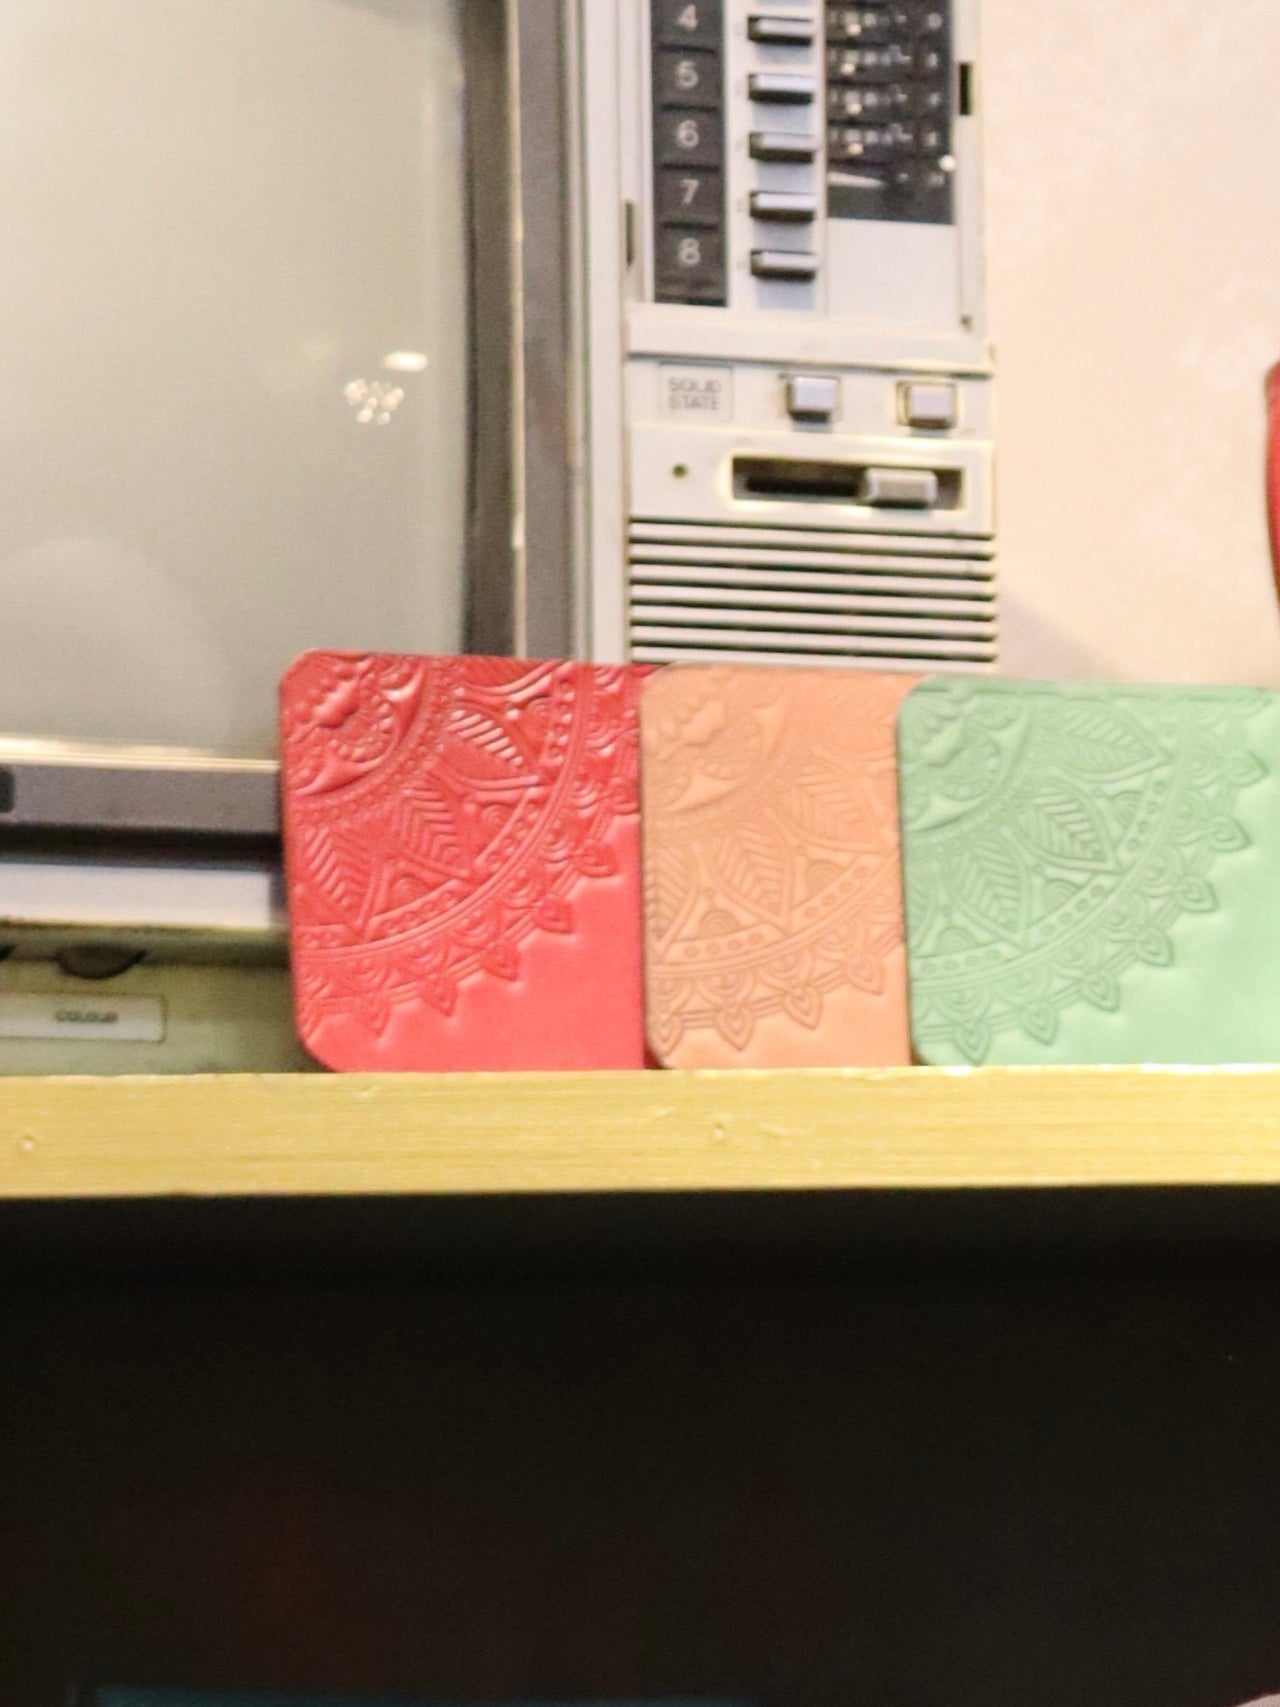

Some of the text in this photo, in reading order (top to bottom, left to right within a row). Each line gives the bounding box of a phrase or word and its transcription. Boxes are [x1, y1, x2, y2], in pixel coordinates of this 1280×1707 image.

[678, 4, 697, 30] 4
[676, 61, 698, 88] 5
[676, 119, 699, 148] 6
[679, 178, 699, 204] 7
[678, 237, 700, 266] 8
